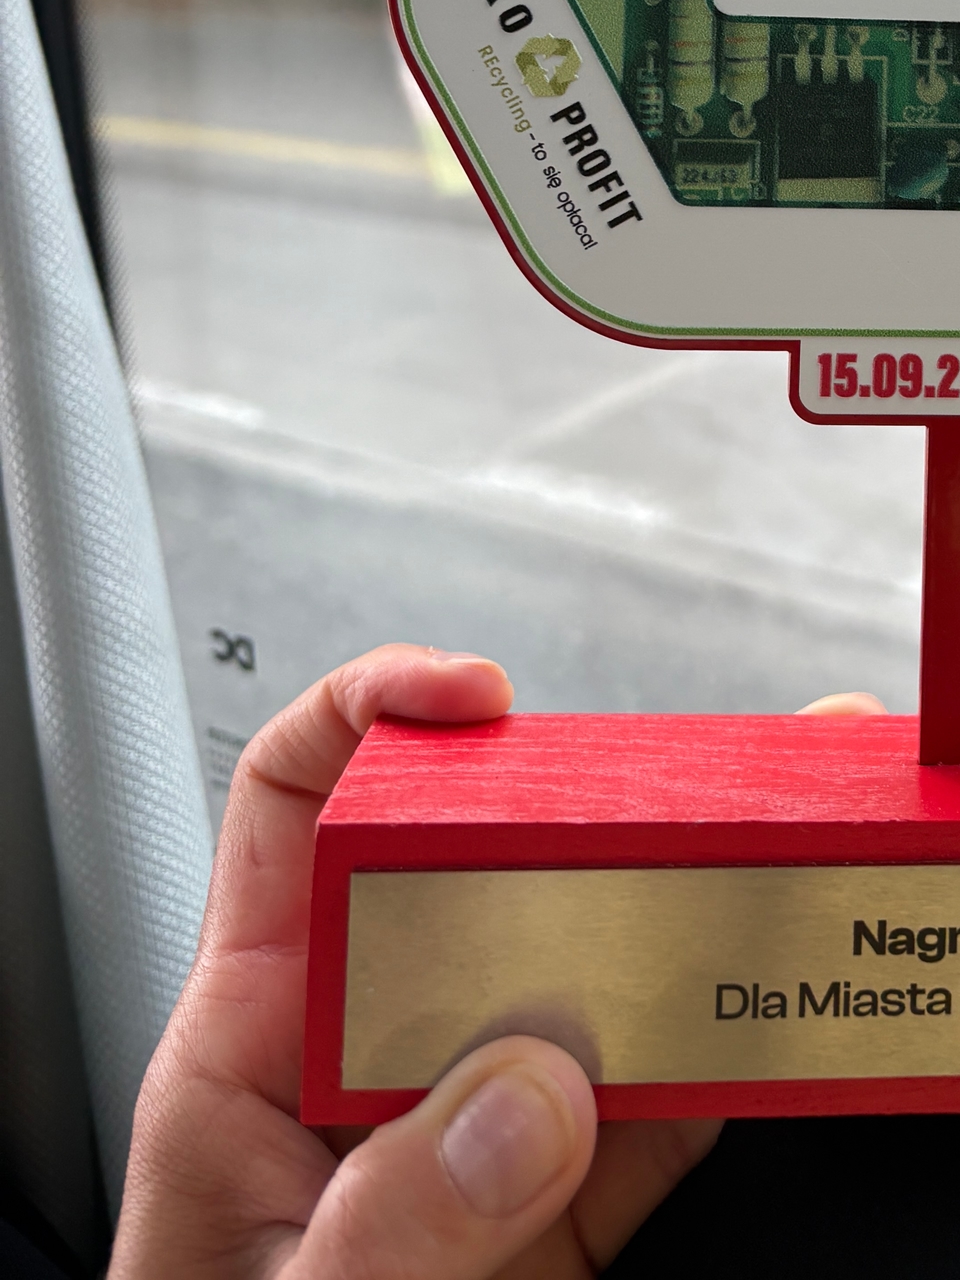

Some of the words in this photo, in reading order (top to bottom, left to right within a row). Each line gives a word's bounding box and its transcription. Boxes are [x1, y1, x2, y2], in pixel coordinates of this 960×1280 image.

[478, 45, 532, 133] REcycling
[531, 142, 547, 161] to
[543, 166, 561, 188] się
[557, 191, 598, 250] opłaca!
[550, 101, 643, 229] PROFIT
[715, 982, 787, 1020] Dla
[799, 981, 952, 1018] Miasta
